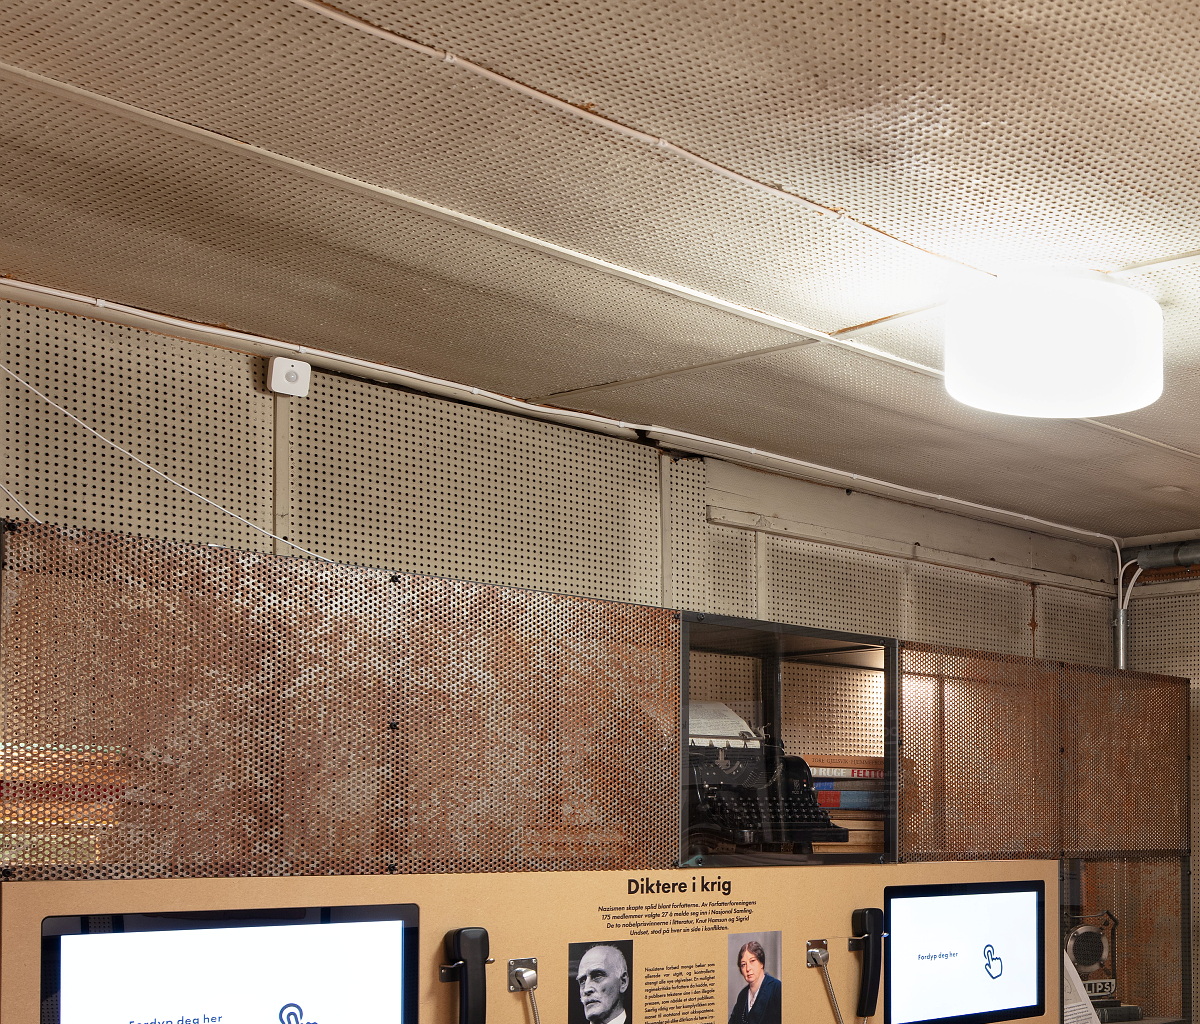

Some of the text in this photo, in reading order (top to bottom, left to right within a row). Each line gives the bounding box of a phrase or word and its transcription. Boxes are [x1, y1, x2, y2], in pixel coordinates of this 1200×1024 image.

[820, 769, 847, 777] RUGE
[627, 876, 731, 896] Diktere i krig
[918, 953, 937, 961] Fordyp
[203, 1014, 222, 1023] her
